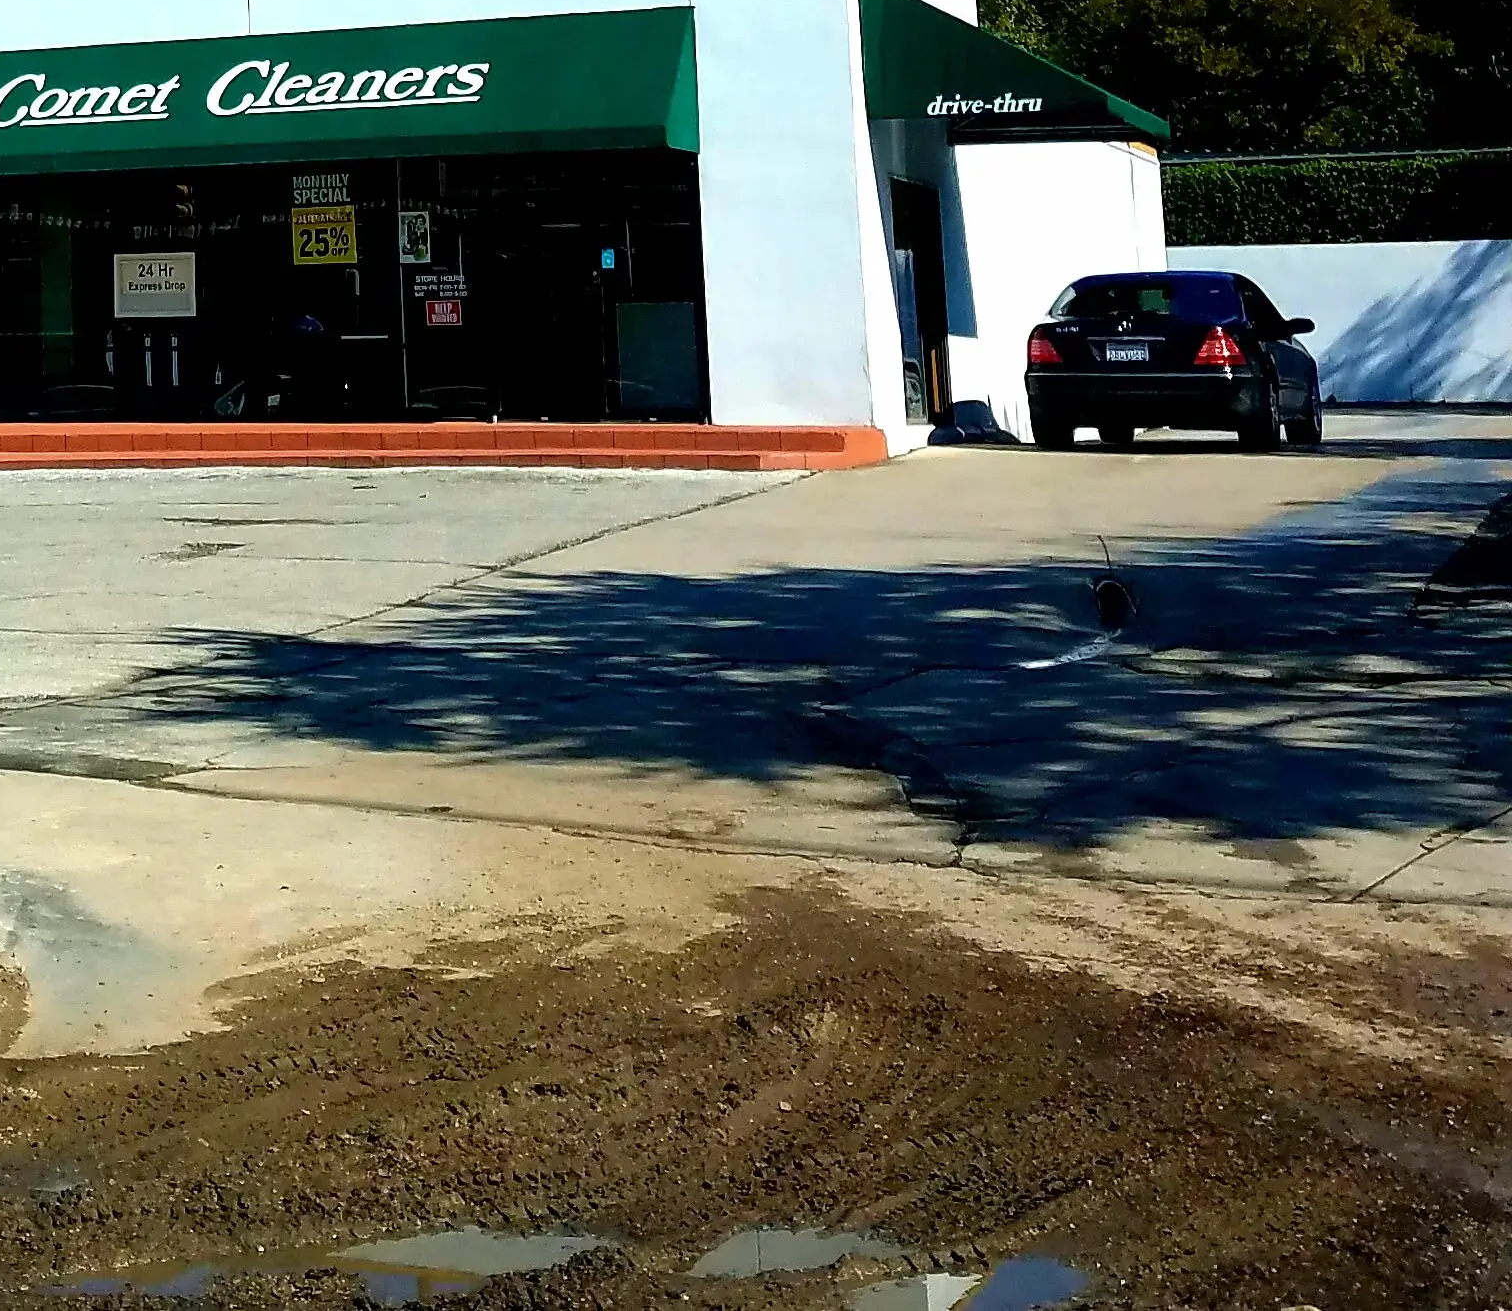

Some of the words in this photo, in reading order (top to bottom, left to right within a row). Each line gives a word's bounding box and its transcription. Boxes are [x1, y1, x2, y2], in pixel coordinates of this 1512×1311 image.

[206, 59, 490, 117] Cleaners
[926, 92, 1043, 116] drive-thru
[292, 173, 350, 189] MONTHLY
[293, 187, 351, 205] SPECIAL
[298, 226, 351, 258] 25%
[330, 247, 350, 257] OFF
[138, 263, 154, 278] 24
[158, 262, 175, 277] Hr
[128, 281, 163, 293] Express
[164, 280, 186, 292] Drop
